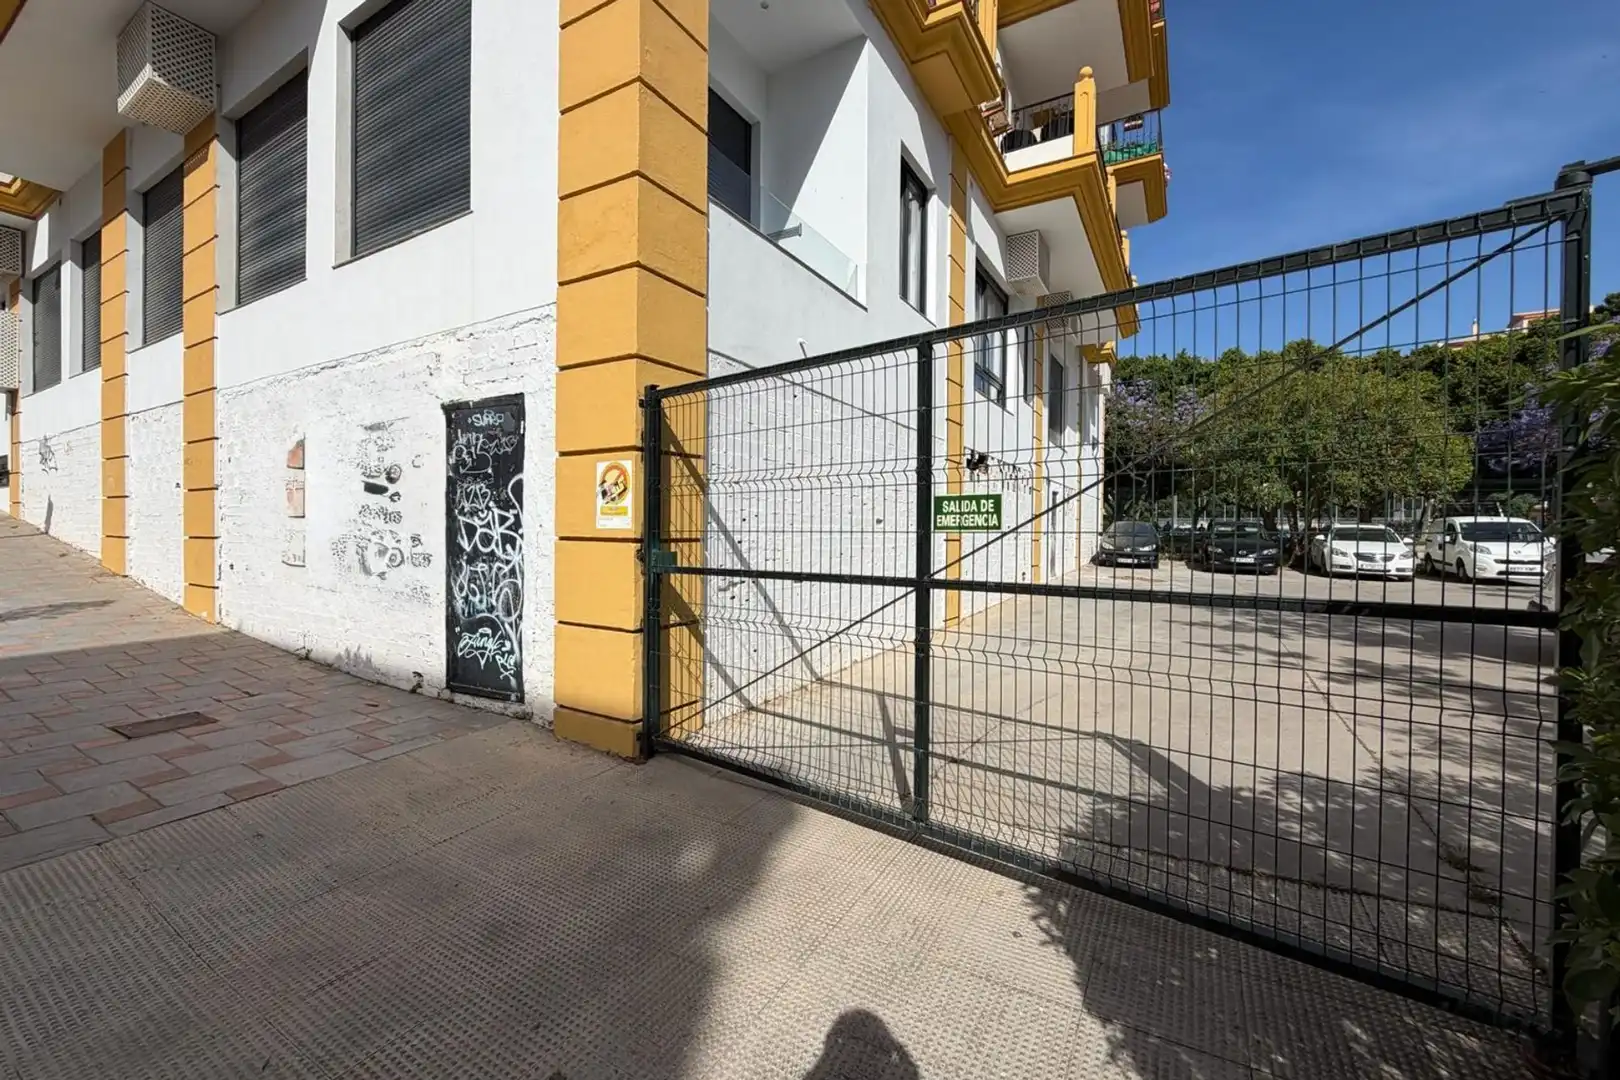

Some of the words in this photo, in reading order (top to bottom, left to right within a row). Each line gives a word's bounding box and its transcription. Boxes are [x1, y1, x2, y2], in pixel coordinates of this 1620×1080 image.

[942, 500, 978, 513] SALIDA
[980, 499, 995, 512] DE
[936, 513, 999, 527] EMERGENCIA
